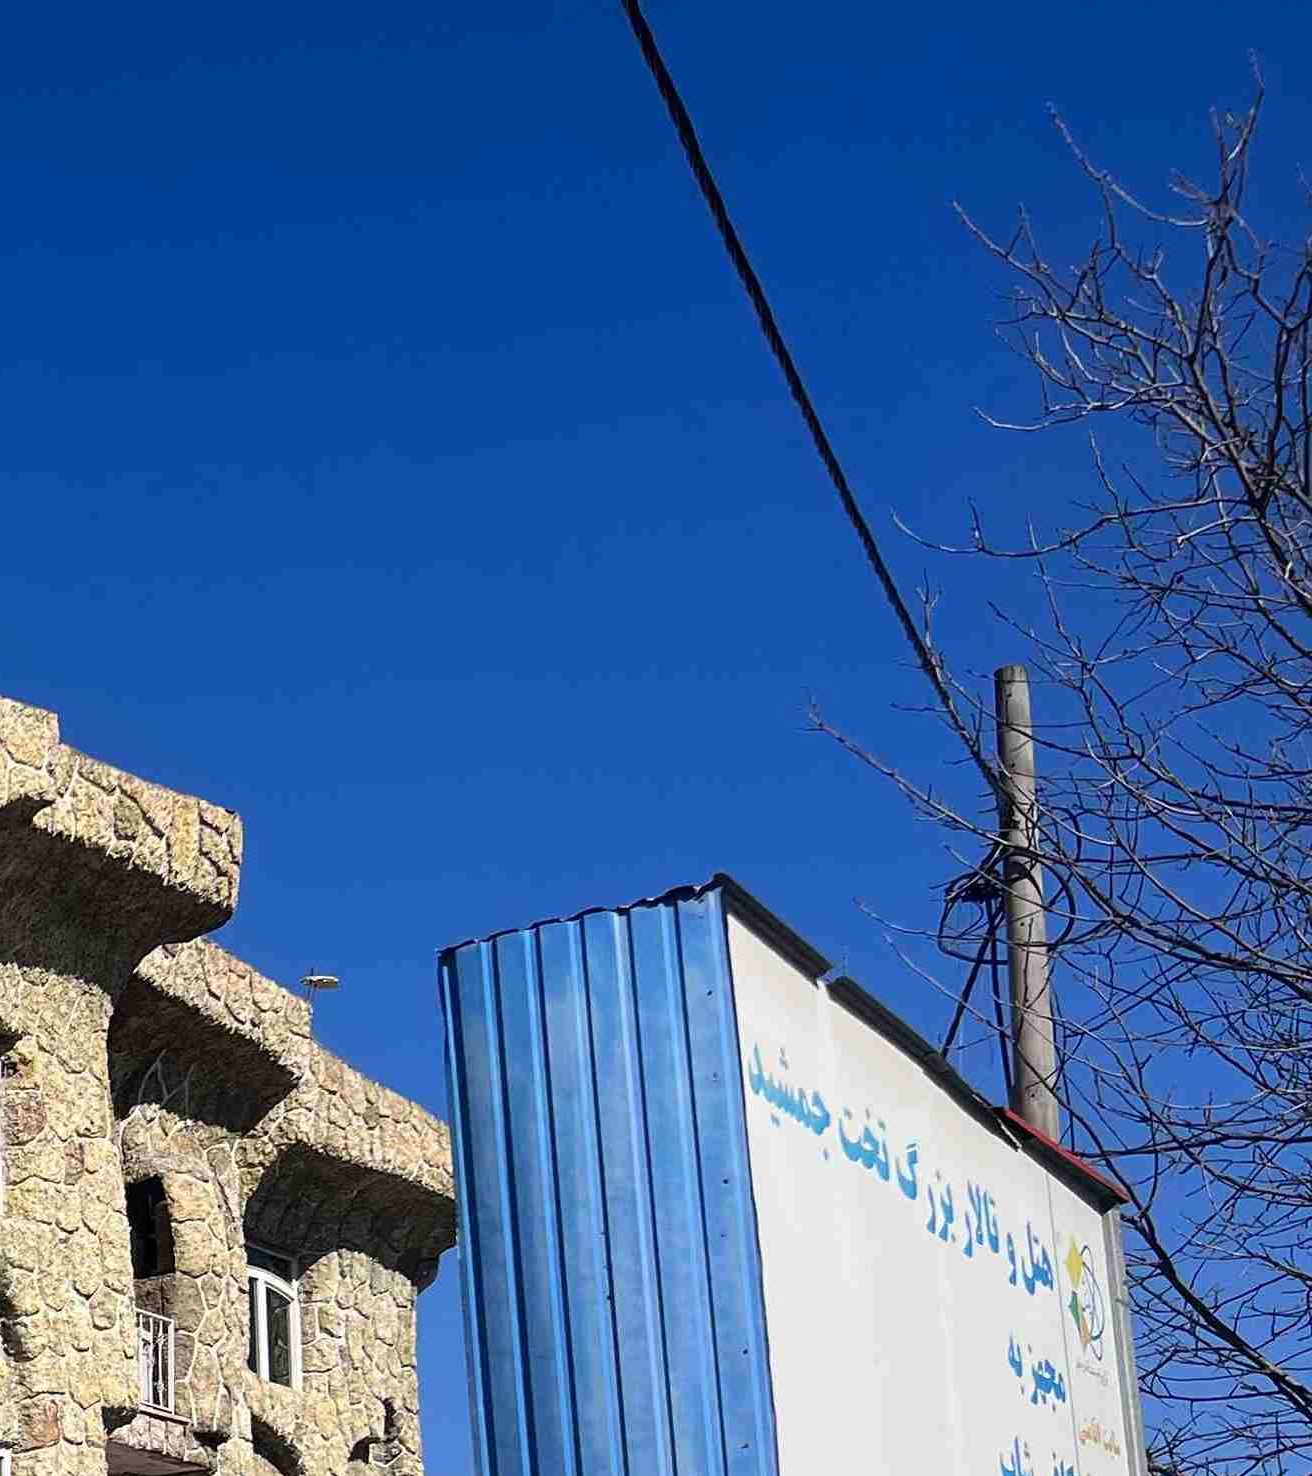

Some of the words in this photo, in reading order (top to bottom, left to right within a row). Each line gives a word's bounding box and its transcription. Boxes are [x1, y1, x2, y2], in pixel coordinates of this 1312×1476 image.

[748, 1042, 831, 1162] جمشید
[837, 1106, 890, 1182] تخت
[963, 1179, 1000, 1259] تالار
[1006, 1231, 1018, 1288] و
[1021, 1219, 1054, 1296] هتل
[1008, 1329, 1025, 1396] به
